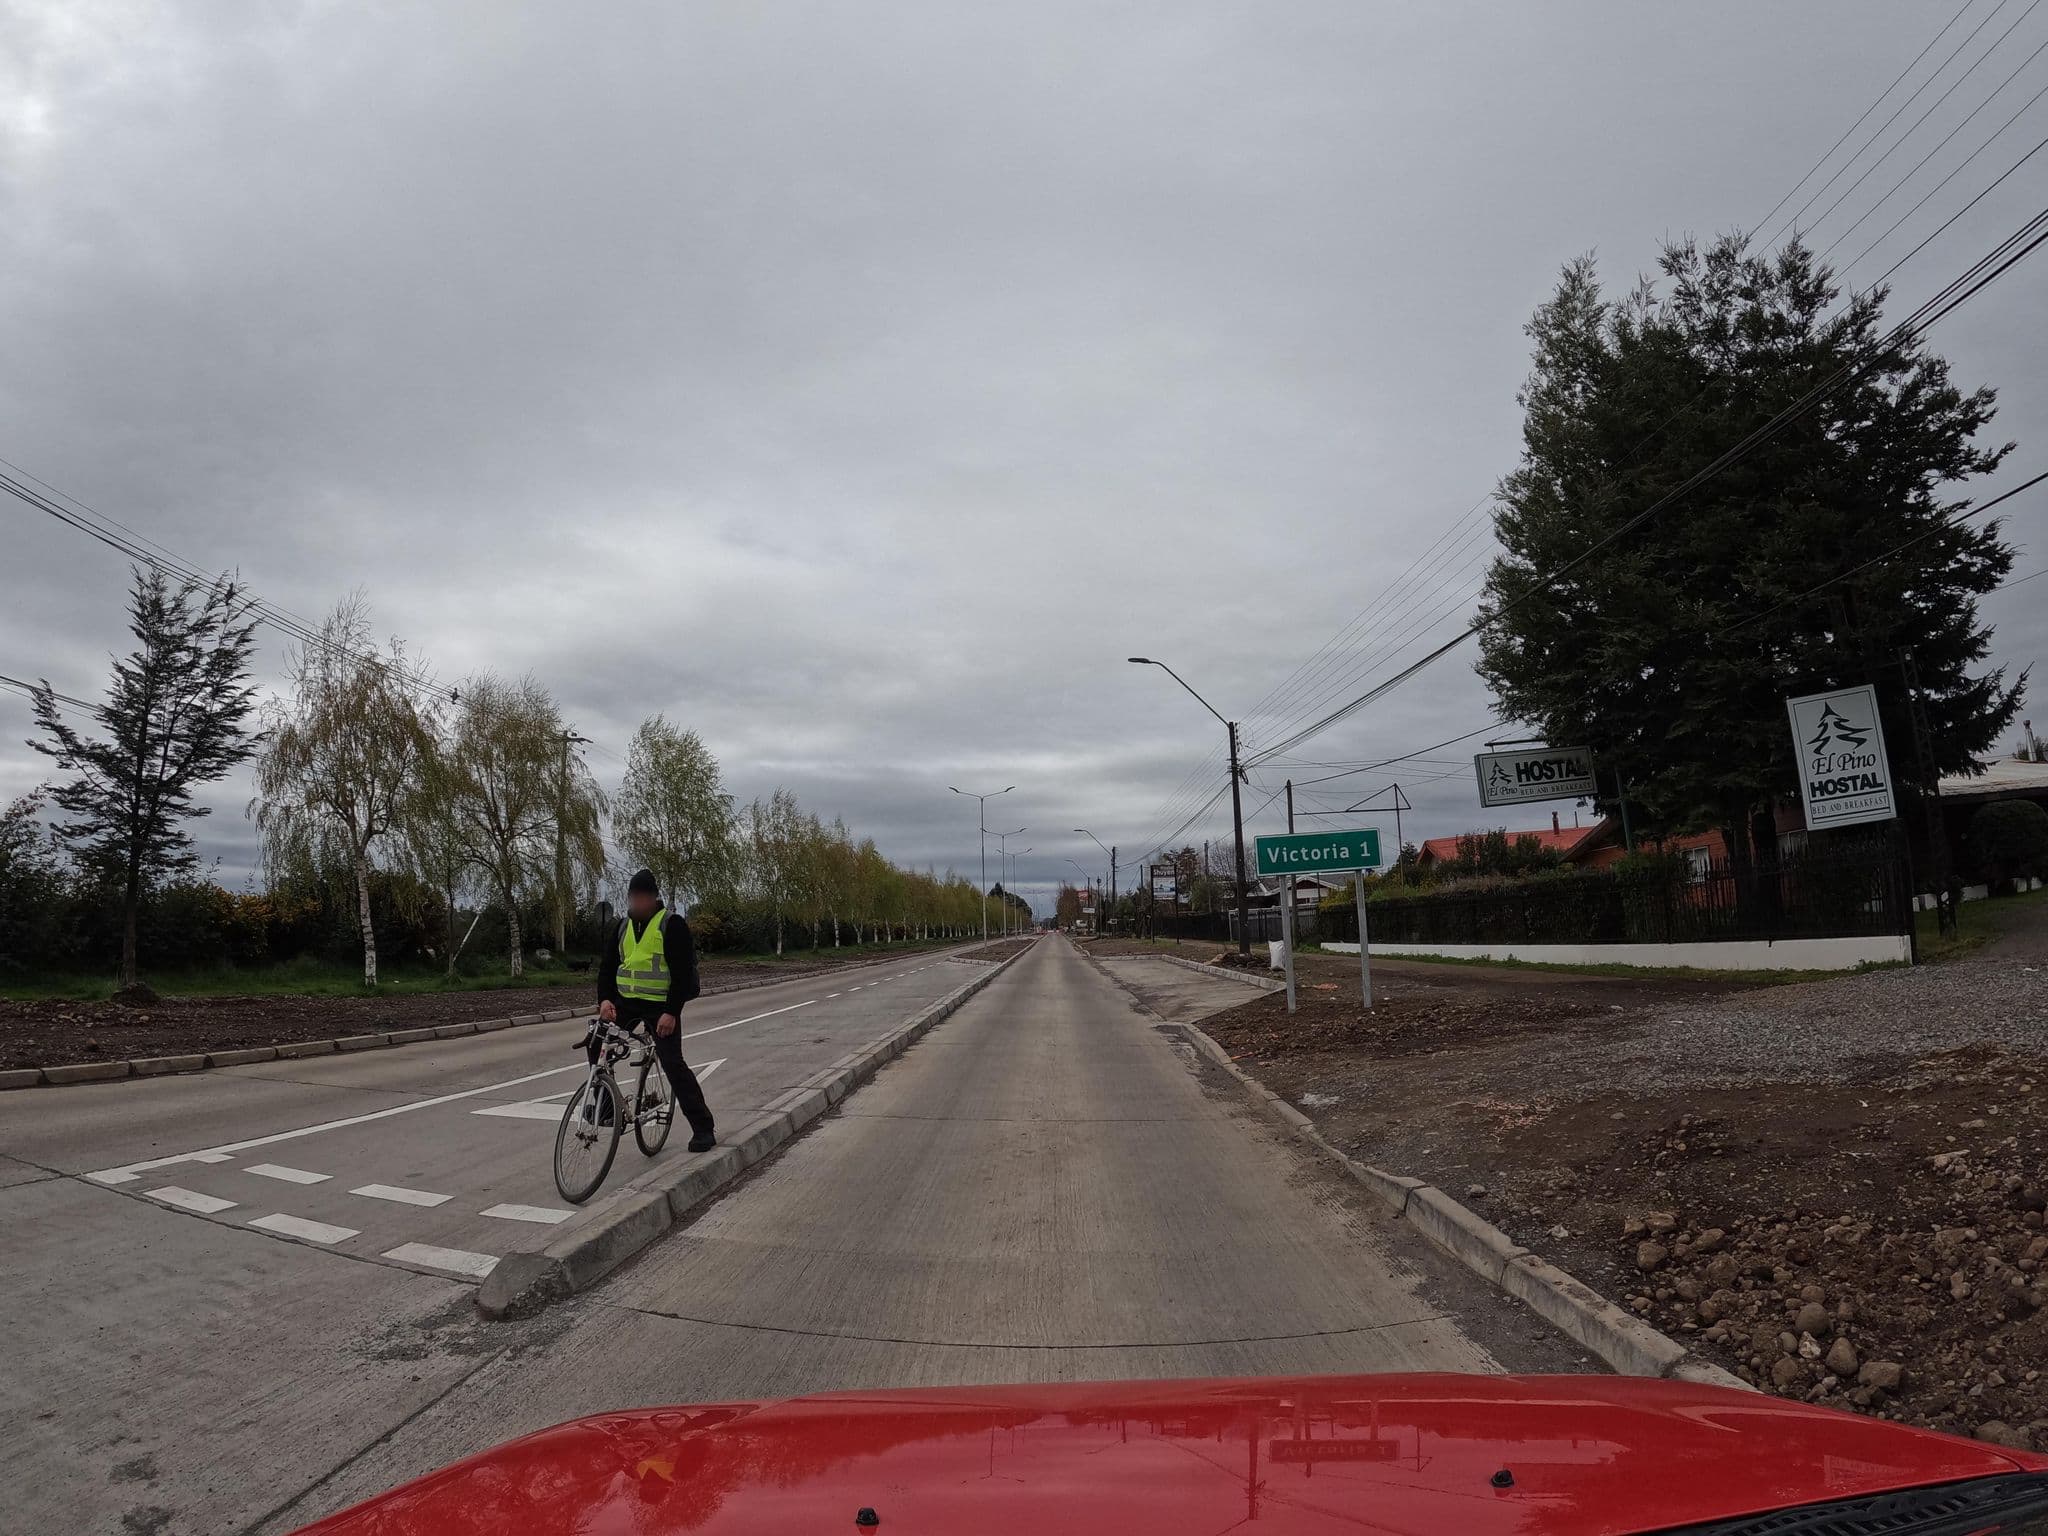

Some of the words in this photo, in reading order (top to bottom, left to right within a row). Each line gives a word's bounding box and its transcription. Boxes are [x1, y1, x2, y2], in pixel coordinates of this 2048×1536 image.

[1812, 752, 1836, 775] El
[1837, 751, 1876, 772] Pino
[1488, 786, 1498, 797] El
[1810, 772, 1884, 798] HOSTAL
[1811, 805, 1827, 815] BED
[1830, 802, 1842, 812] AND
[1844, 795, 1888, 810] BREAKFAST
[1266, 843, 1350, 863] Victoria
[1360, 841, 1371, 857] 1
